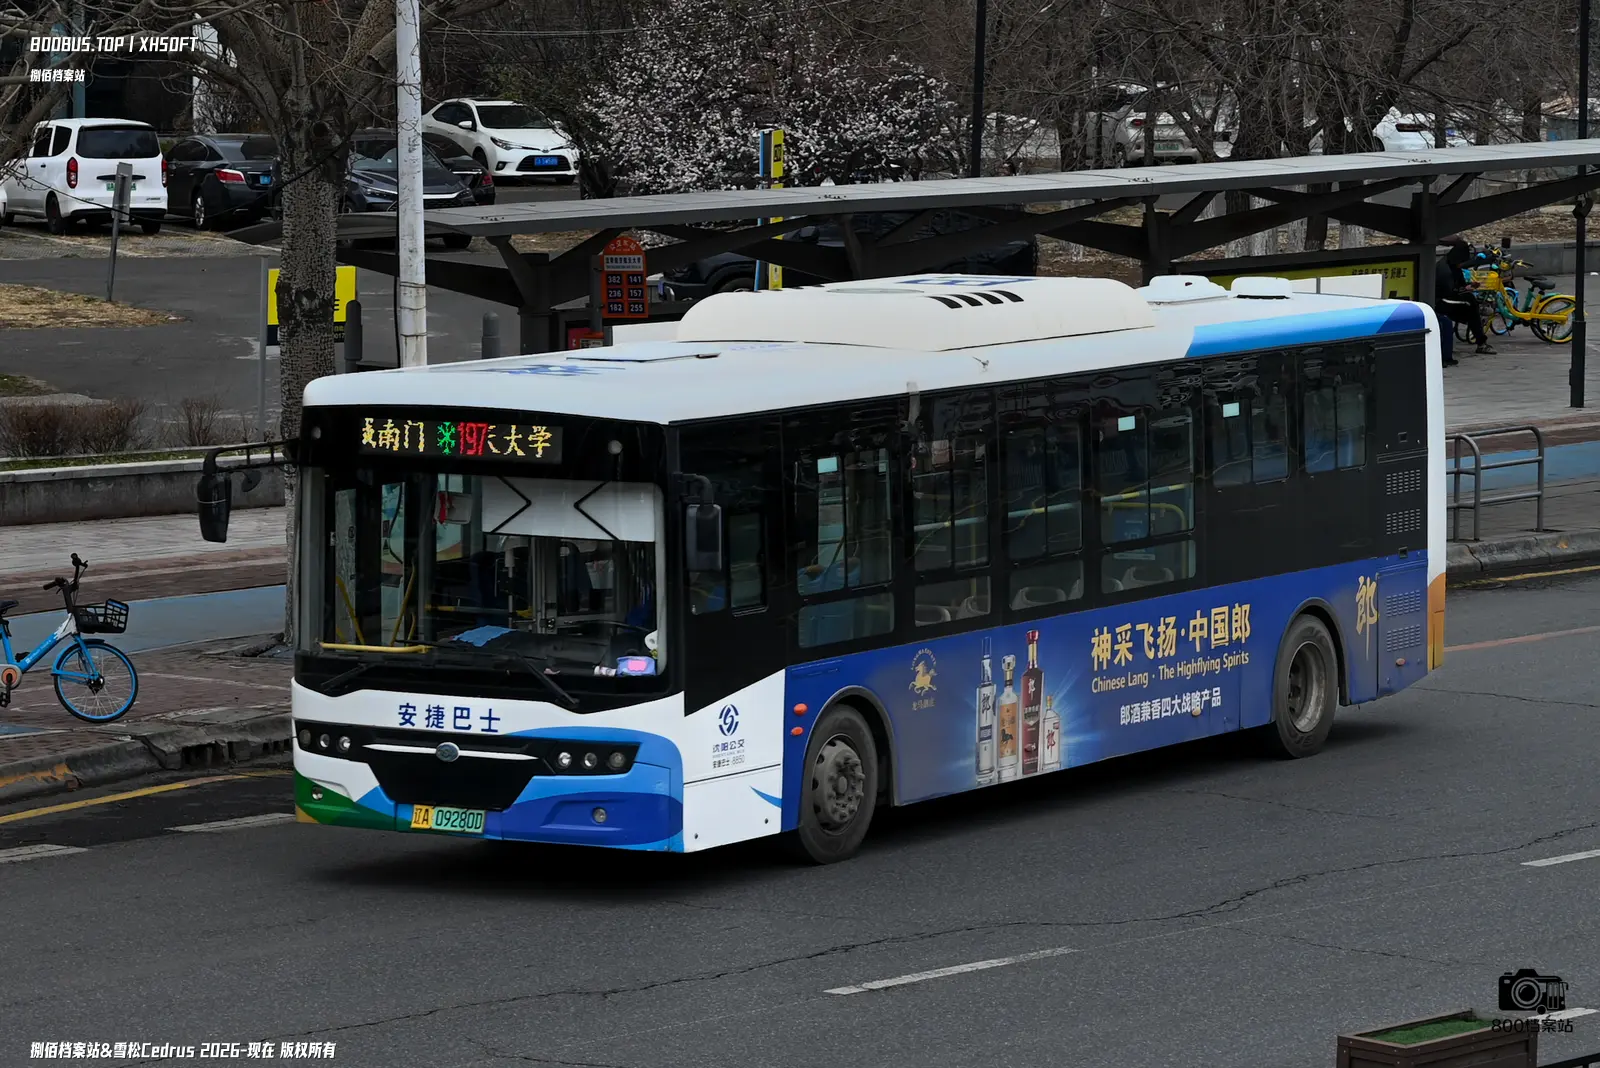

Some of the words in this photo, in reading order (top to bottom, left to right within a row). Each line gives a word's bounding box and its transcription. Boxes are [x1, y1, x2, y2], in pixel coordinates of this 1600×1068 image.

[630, 304, 643, 312] 255
[457, 421, 489, 456] 197
[1091, 603, 1250, 672] 神采飞扬·中国郎
[1091, 675, 1126, 693] Chinese
[1128, 670, 1149, 688] Lang
[1158, 664, 1174, 681] The
[1176, 657, 1221, 680] Highflying
[1223, 650, 1249, 672] Spirits
[398, 703, 501, 733] 安捷巴士
[1120, 687, 1222, 726] 郎酒兼香四大战略产品
